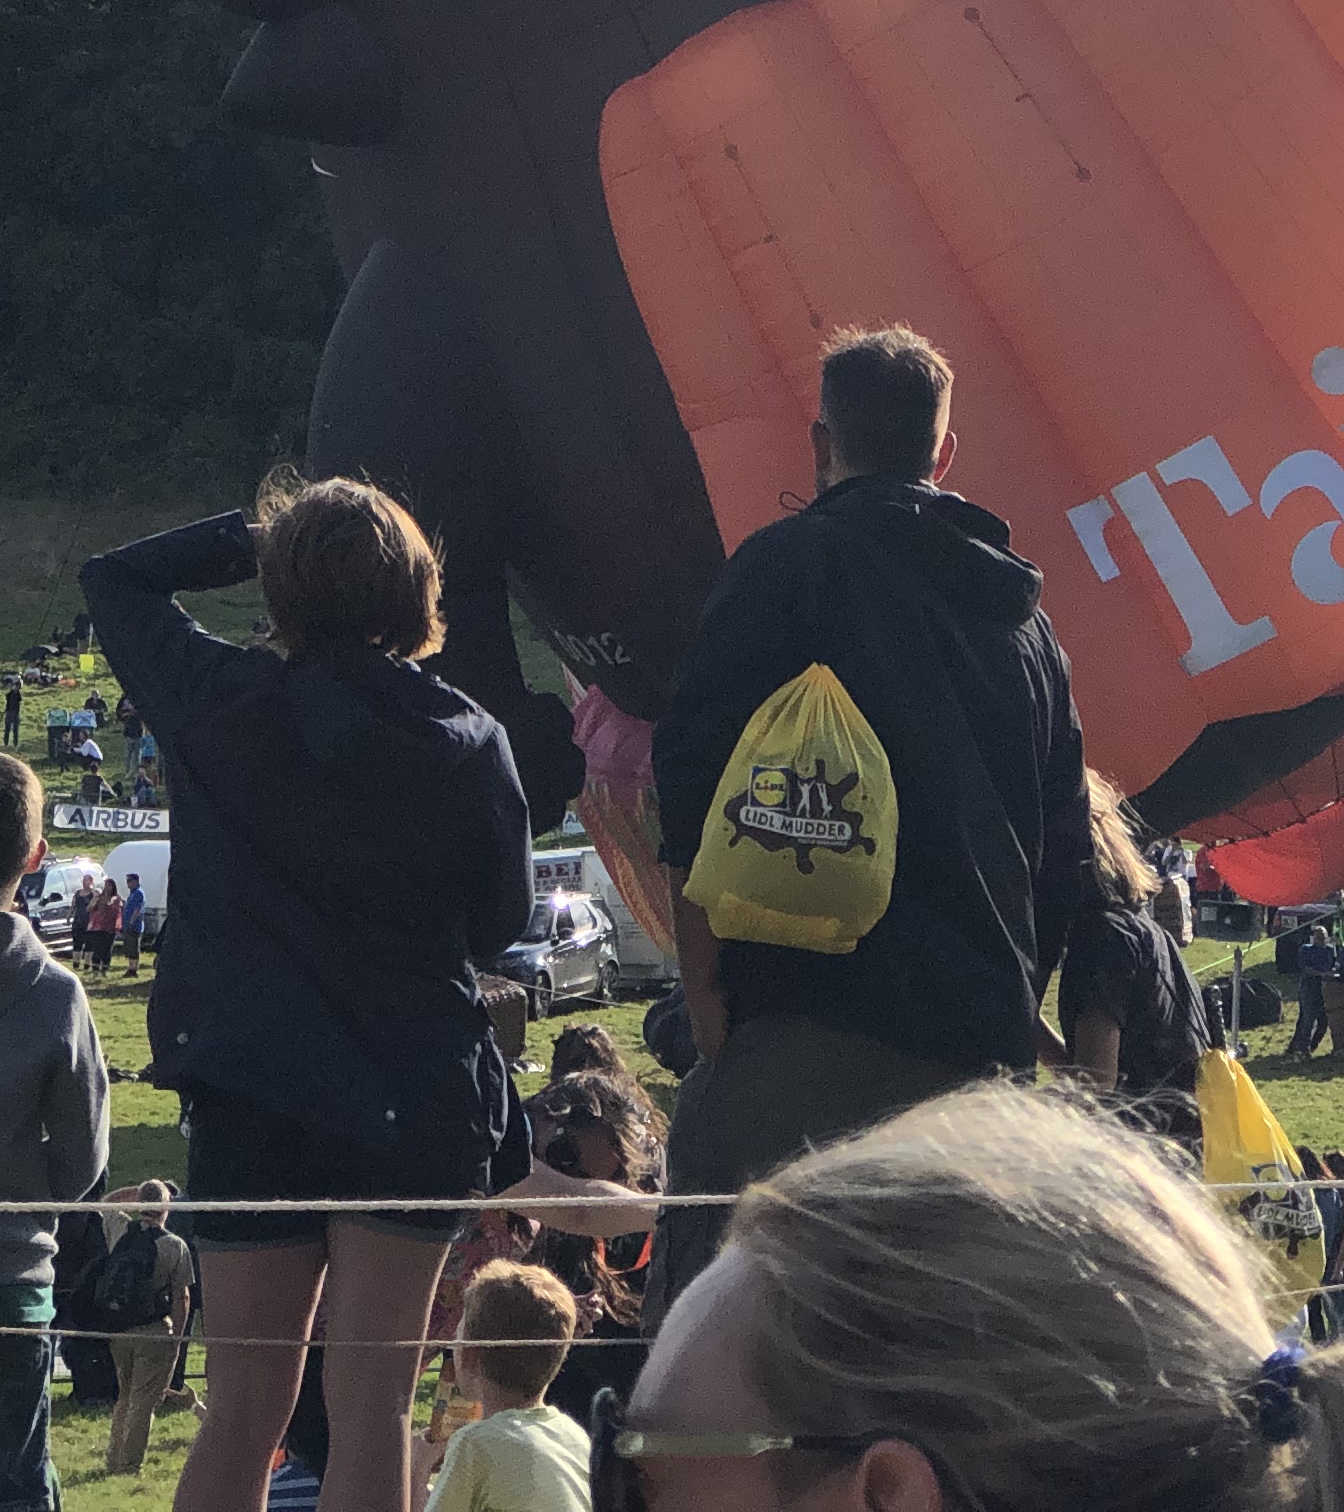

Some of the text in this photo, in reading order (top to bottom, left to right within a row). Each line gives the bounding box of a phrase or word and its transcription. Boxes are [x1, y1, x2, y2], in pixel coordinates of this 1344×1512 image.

[67, 808, 161, 829] AIRBUS
[745, 808, 846, 837] LIDL MUDDER
